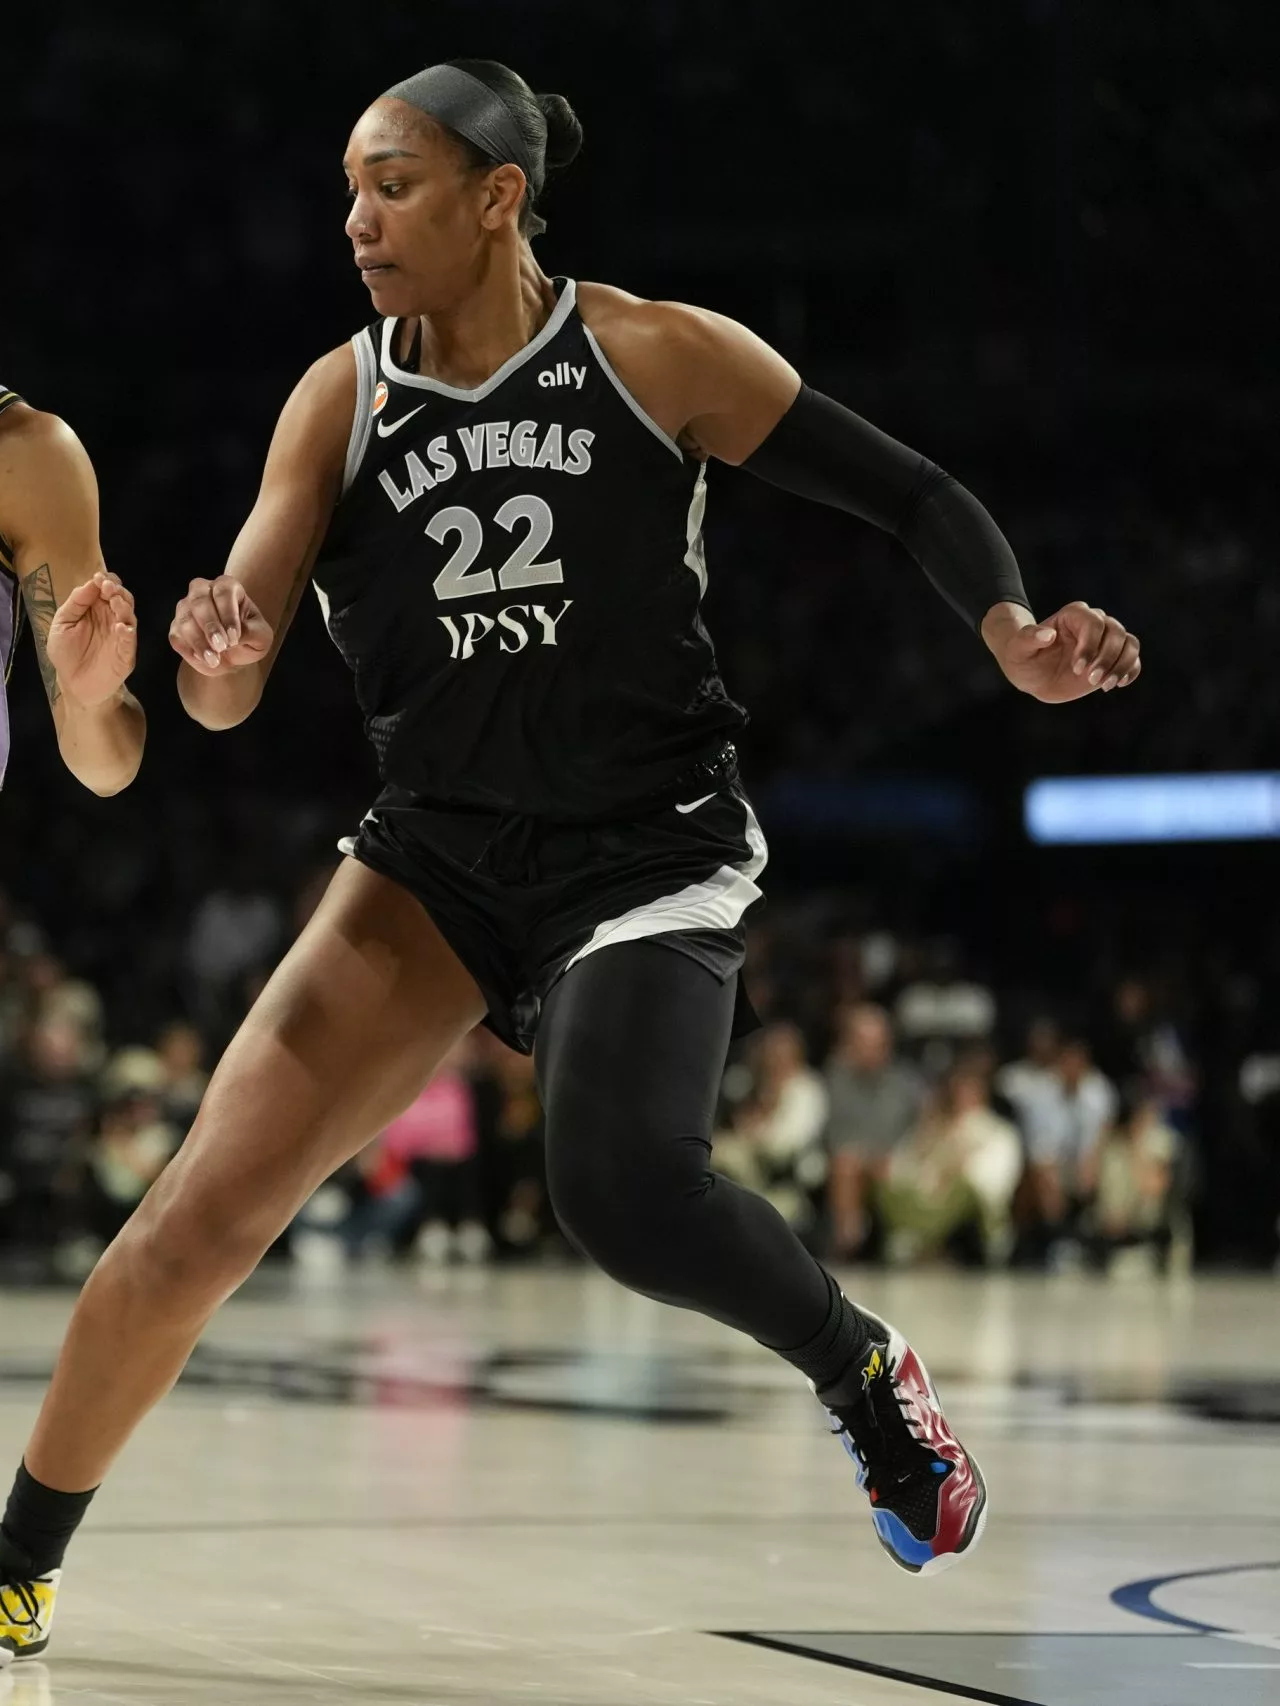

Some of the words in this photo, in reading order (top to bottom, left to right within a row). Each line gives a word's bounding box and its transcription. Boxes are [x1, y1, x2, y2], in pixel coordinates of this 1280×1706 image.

[537, 361, 587, 390] ally
[377, 435, 457, 513] LAS
[457, 420, 596, 475] VEGAS
[424, 494, 564, 600] 22
[437, 600, 574, 660] IPSY
